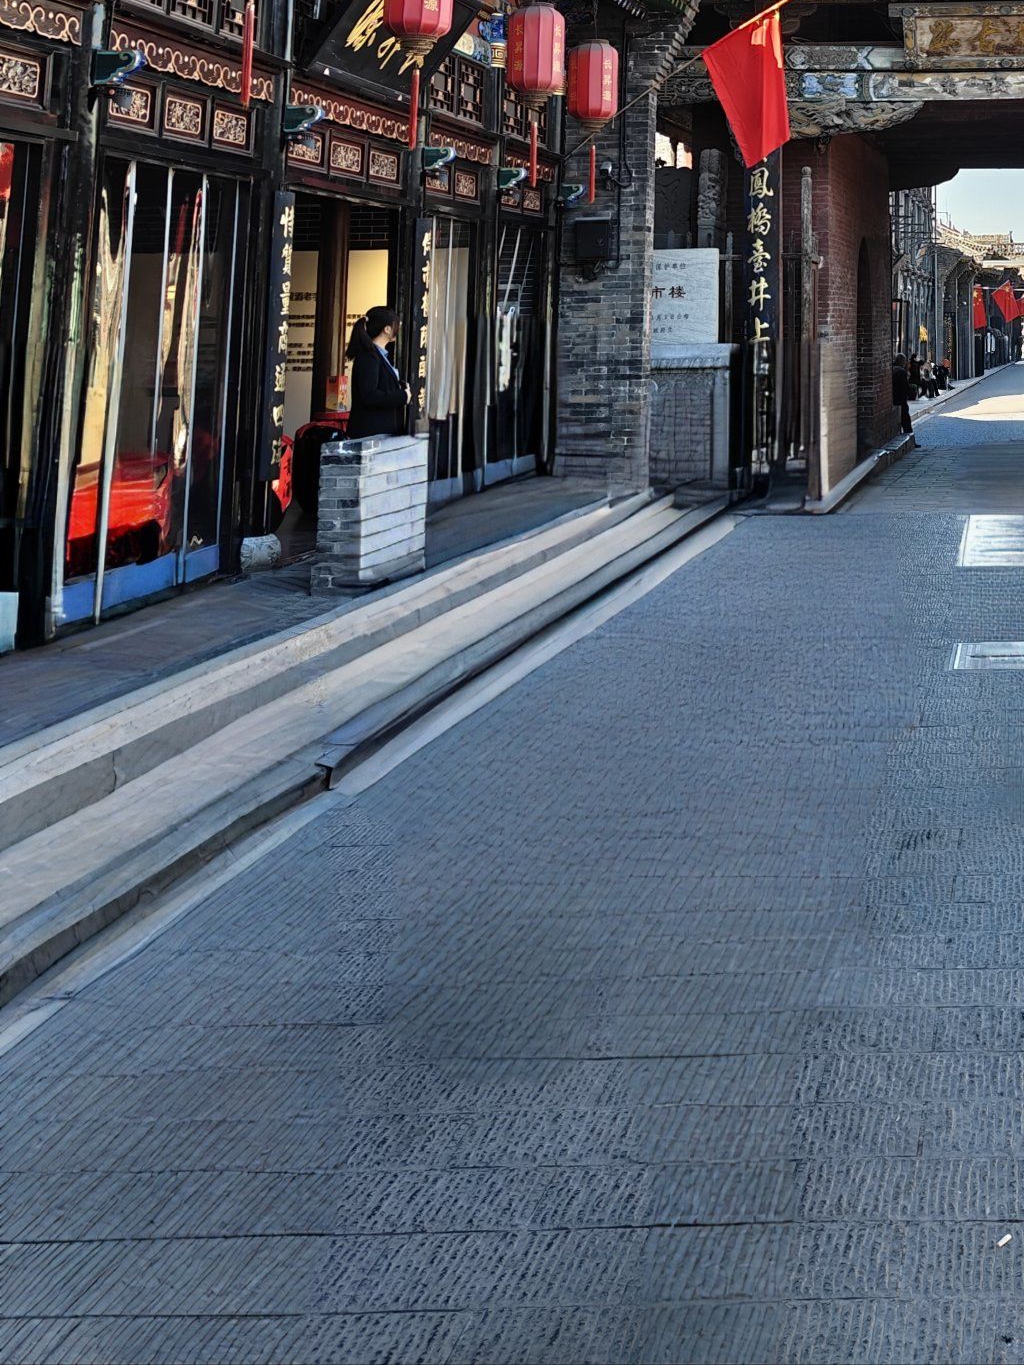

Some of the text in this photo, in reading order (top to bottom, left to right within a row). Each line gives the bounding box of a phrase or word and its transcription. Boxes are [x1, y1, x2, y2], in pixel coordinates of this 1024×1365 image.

[651, 285, 686, 299] 市楼
[747, 157, 774, 343] 鳳橋臺井上
